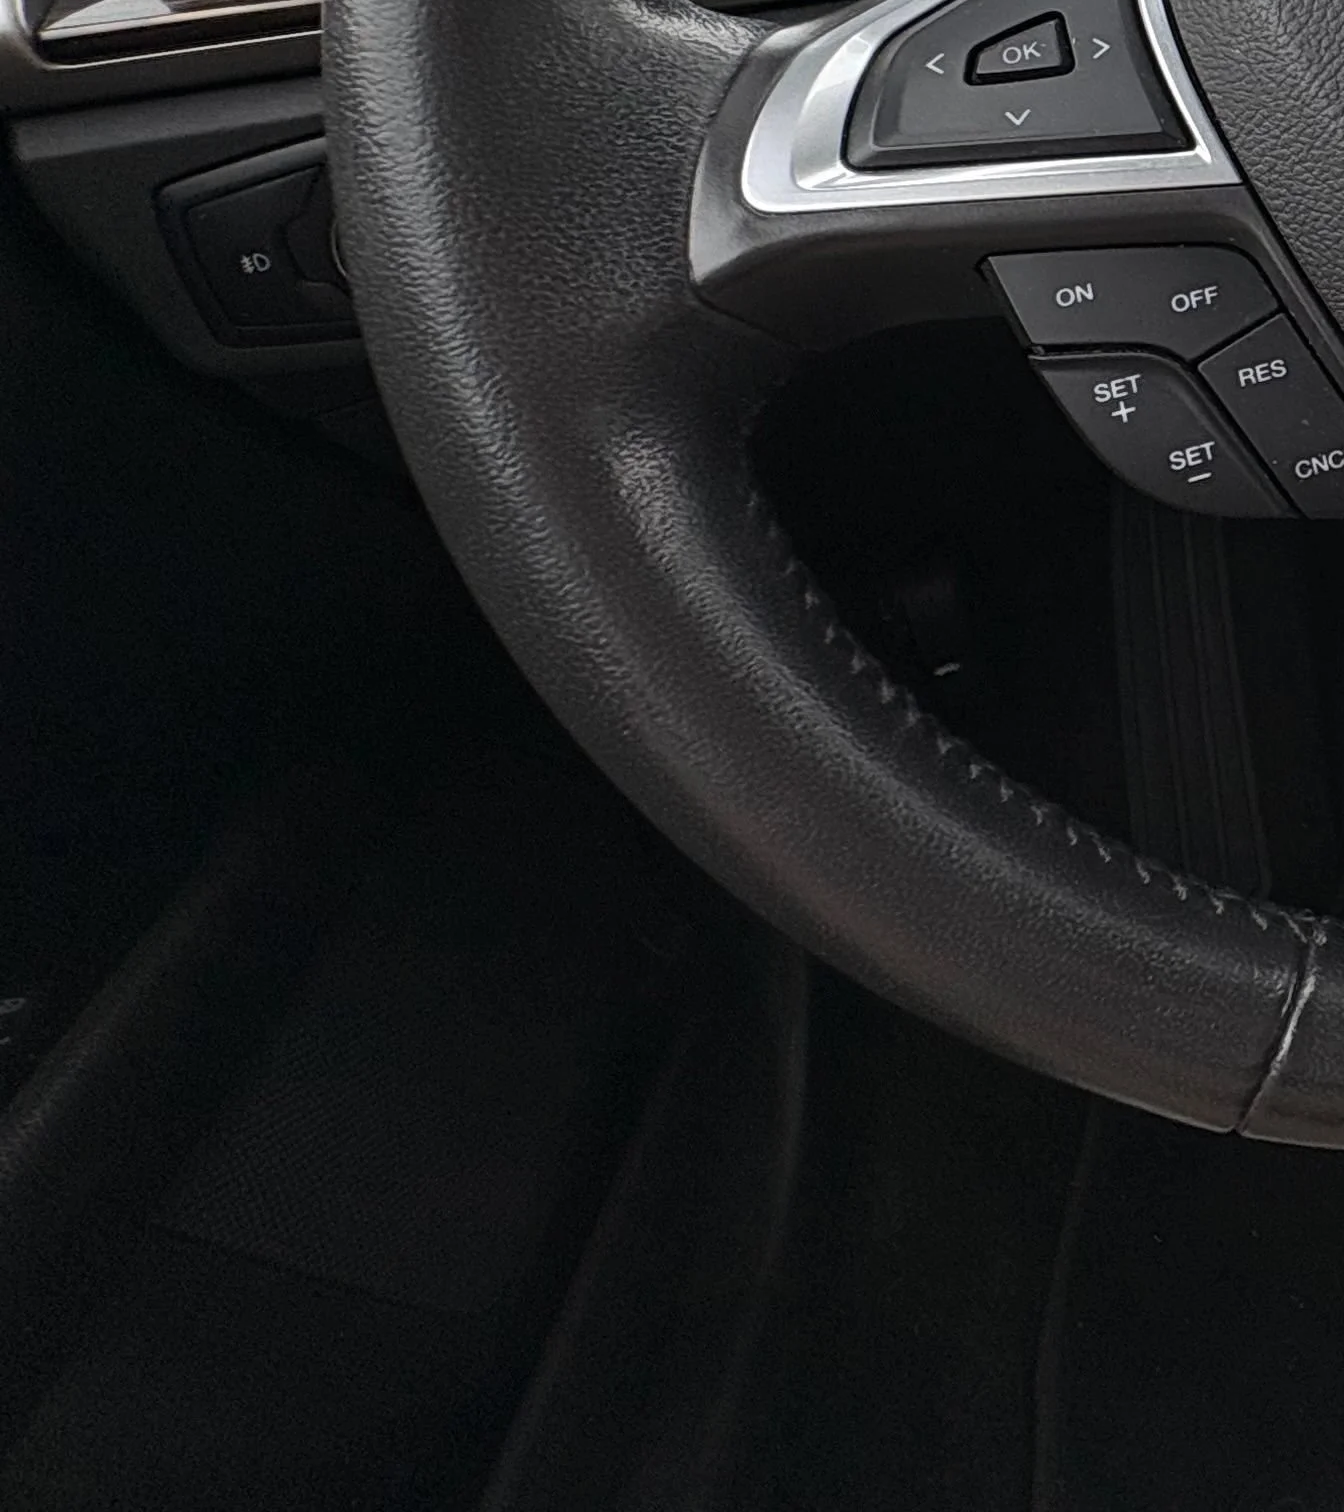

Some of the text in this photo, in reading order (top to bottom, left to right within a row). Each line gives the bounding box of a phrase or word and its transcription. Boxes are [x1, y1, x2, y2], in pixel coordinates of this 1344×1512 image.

[1002, 41, 1042, 65] OK
[1055, 283, 1095, 309] ON
[1171, 286, 1219, 313] OFF
[1238, 359, 1288, 387] RES
[1093, 374, 1142, 403] SET
[1169, 441, 1216, 471] SET
